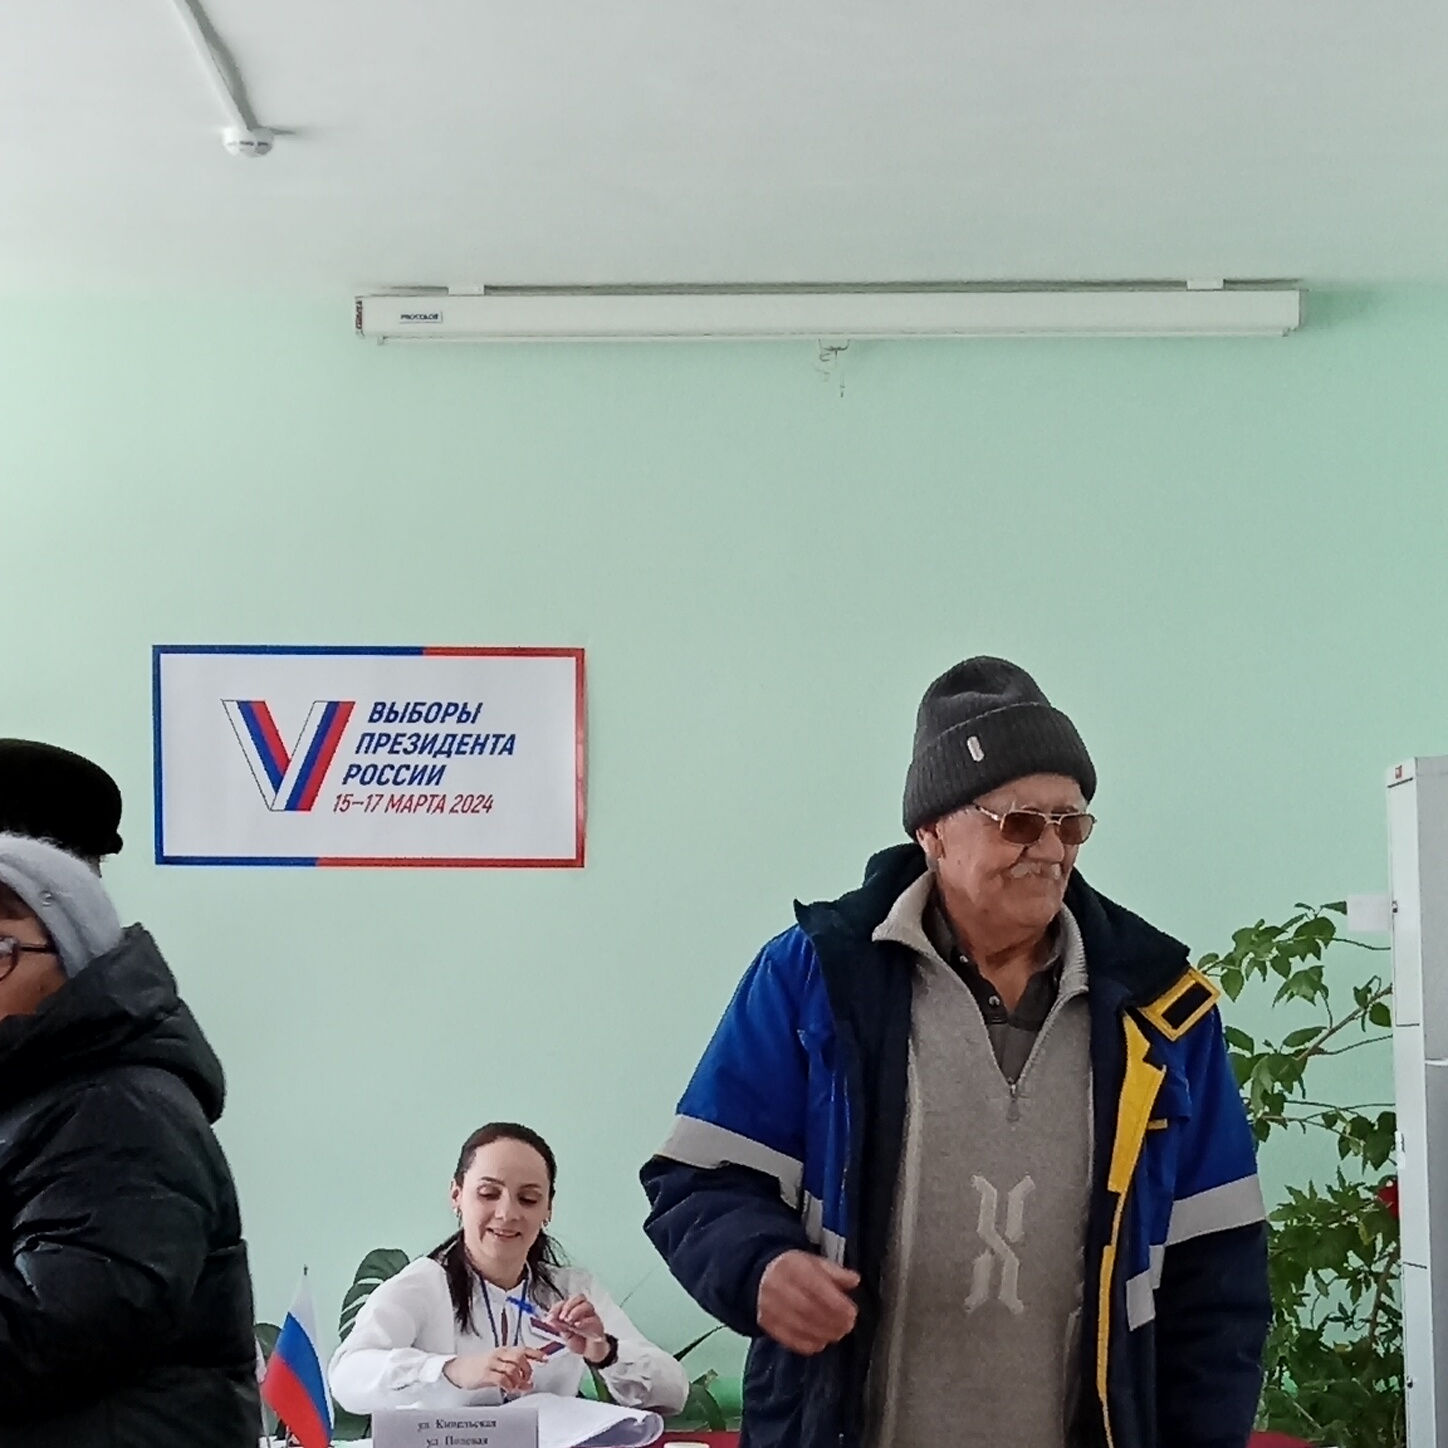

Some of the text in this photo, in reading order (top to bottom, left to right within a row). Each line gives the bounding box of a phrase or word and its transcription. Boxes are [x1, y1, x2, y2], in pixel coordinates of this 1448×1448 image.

[368, 702, 483, 724] ВЫБОРЫ
[355, 732, 516, 758] ПРЕЗИДЕНТА
[342, 764, 447, 785] РОССИИ
[385, 794, 445, 814] МАРТА
[450, 794, 494, 814] 2024
